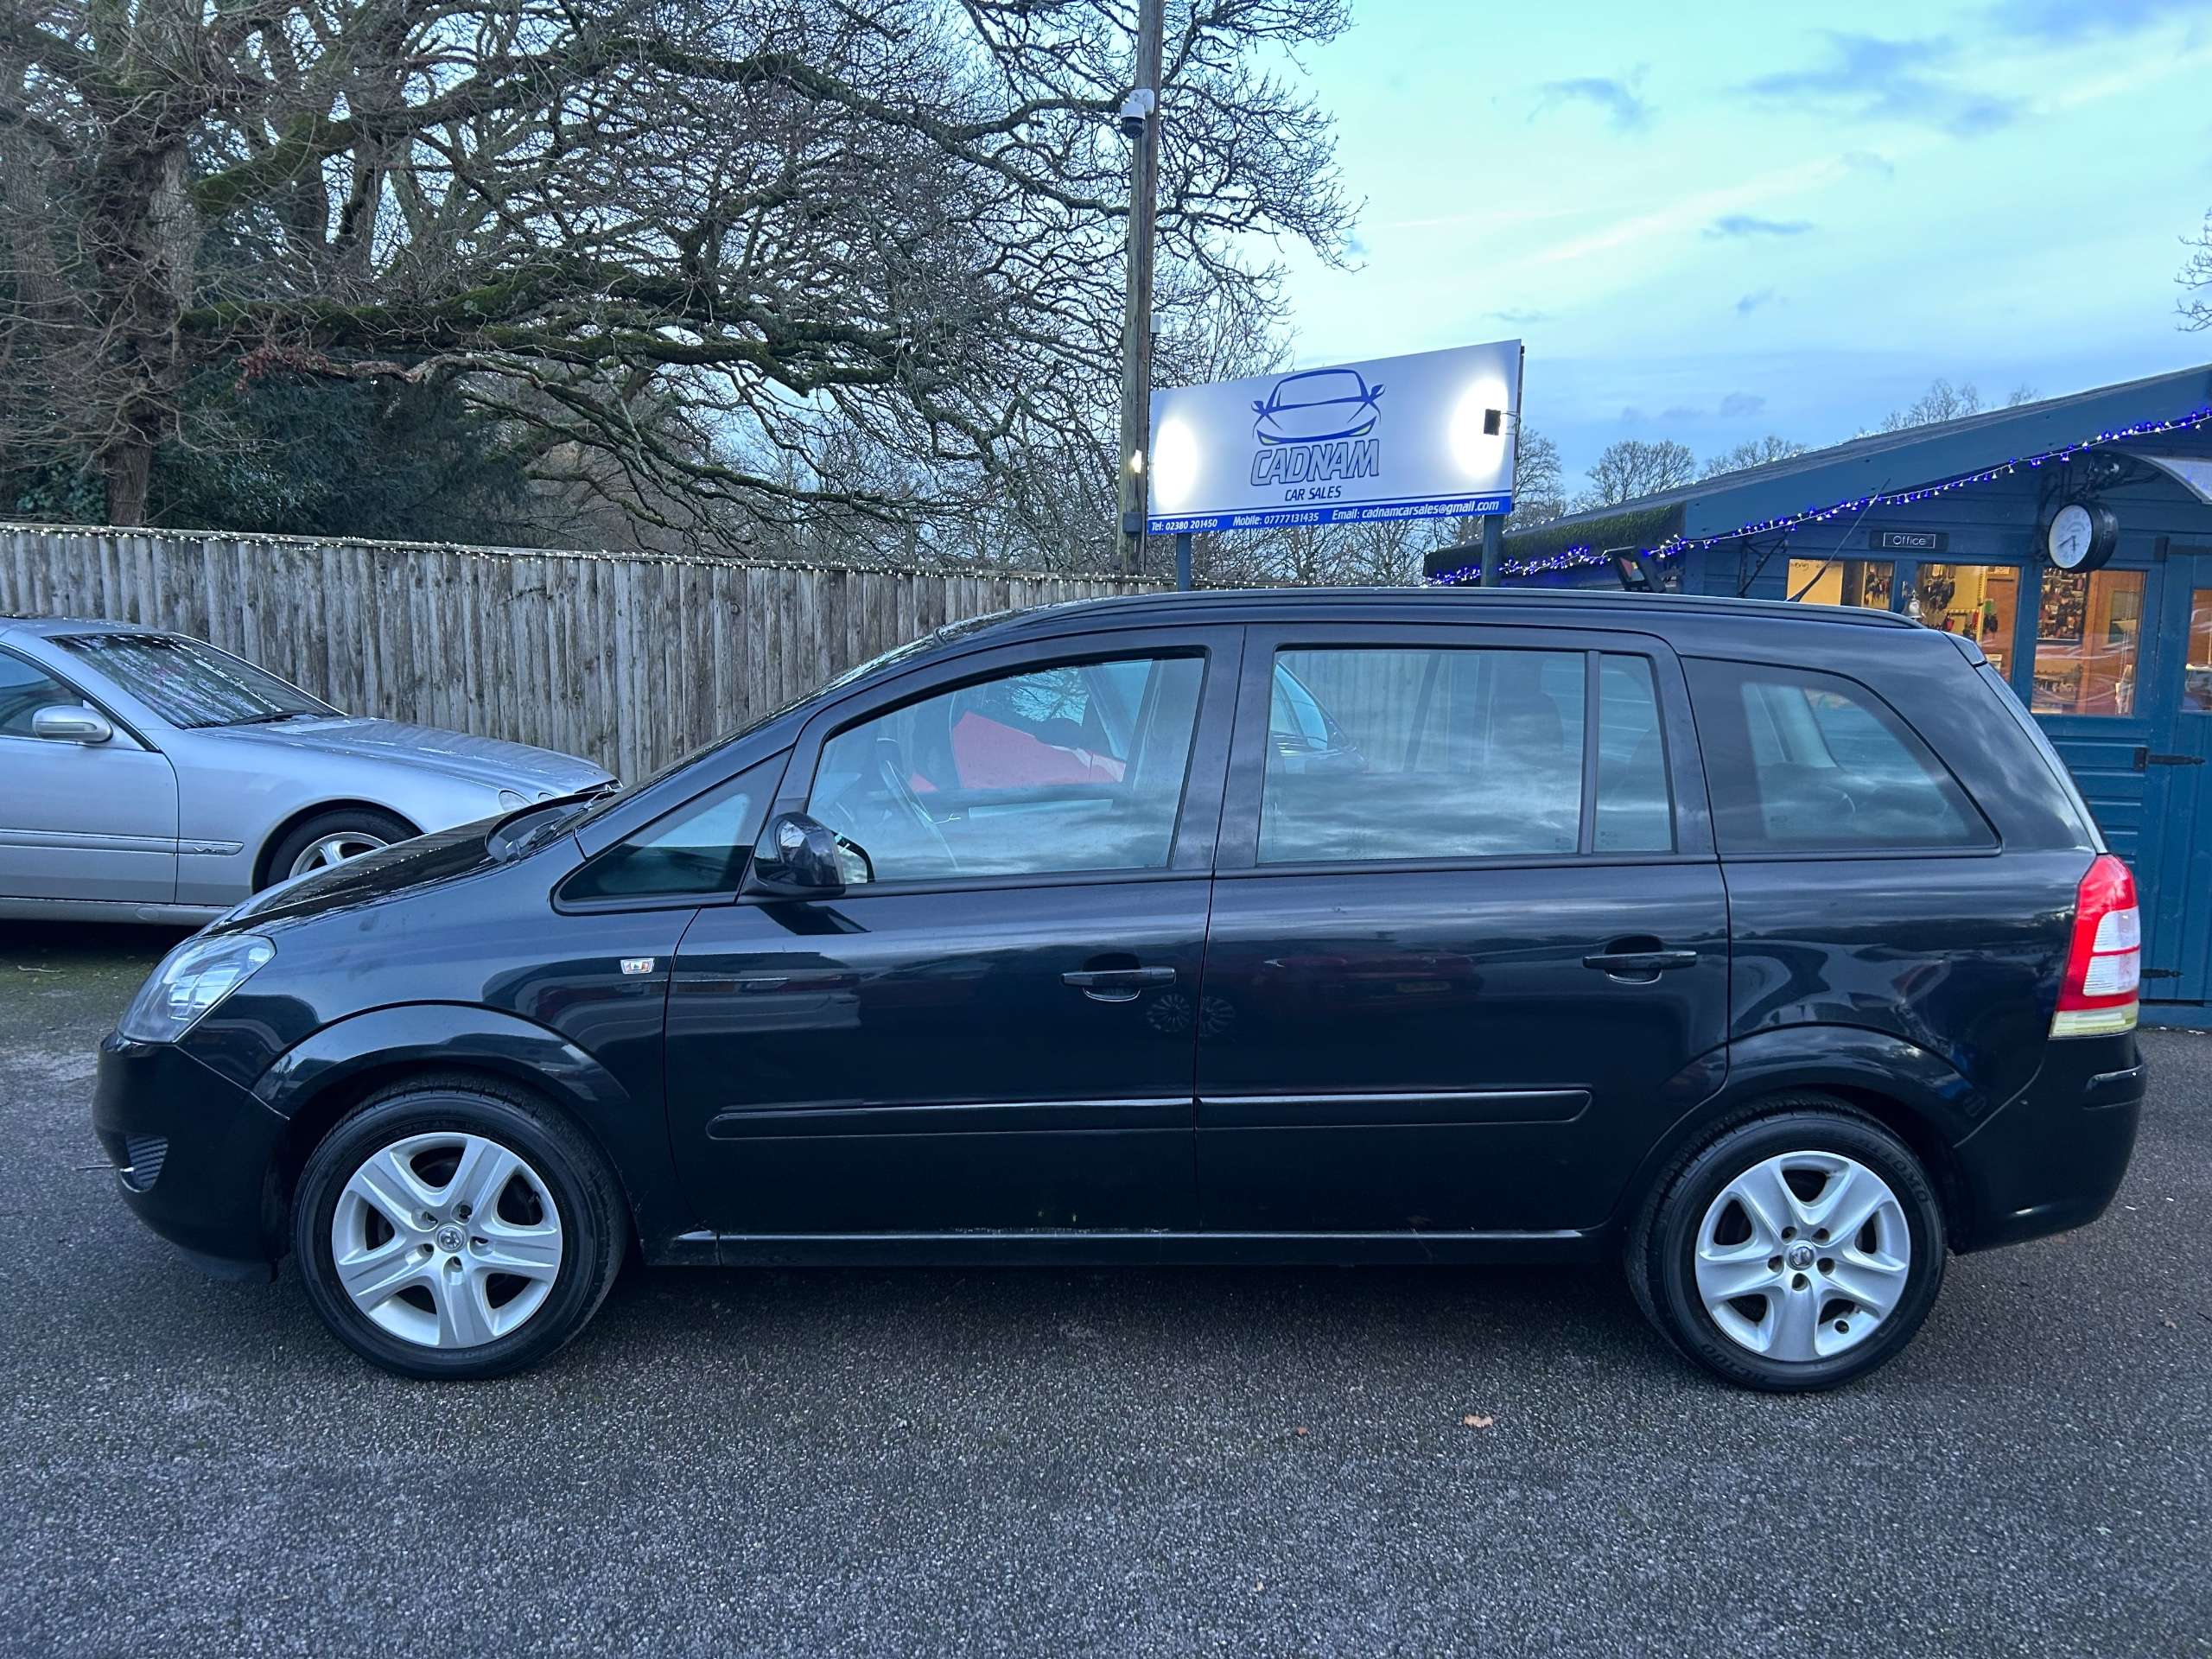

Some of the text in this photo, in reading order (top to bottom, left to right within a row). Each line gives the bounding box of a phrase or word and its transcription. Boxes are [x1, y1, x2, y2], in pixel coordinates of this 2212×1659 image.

[1250, 439, 1379, 486] CADNAM
[1285, 486, 1342, 501] CAR SALES
[1152, 499, 1500, 531] Tel: 02380 201450 Mobile: 07777131435 Email: cadnamcarsales@gmail.com
[1892, 535, 1927, 545] Office
